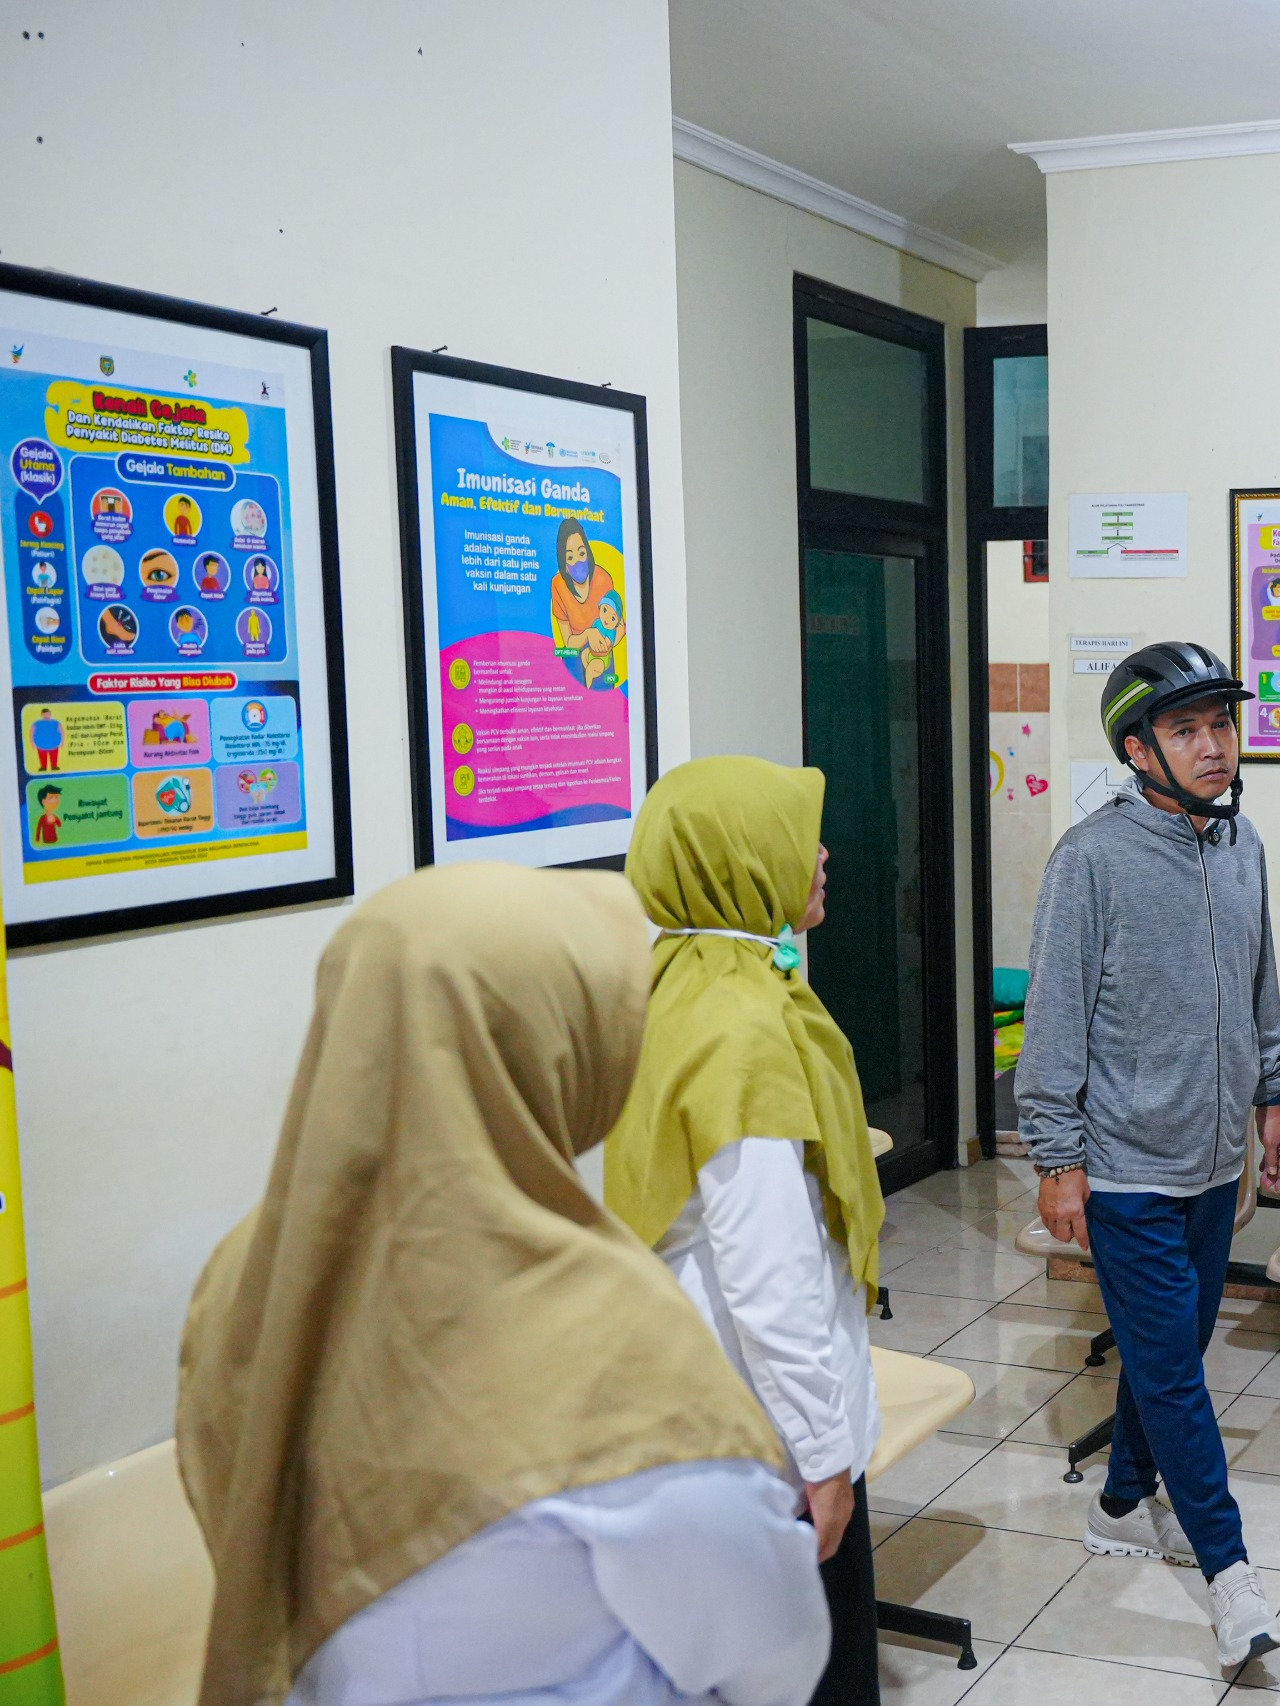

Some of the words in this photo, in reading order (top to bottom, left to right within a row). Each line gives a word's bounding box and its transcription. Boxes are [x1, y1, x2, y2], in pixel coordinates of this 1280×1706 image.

[93, 391, 148, 418] Kenali
[150, 399, 206, 425] Gejala
[68, 410, 91, 425] Dan
[93, 413, 155, 434] Kendalikan
[158, 422, 195, 438] Faktor
[197, 427, 230, 441] Resiko
[66, 424, 119, 443] Penyakit
[121, 431, 168, 448] Diabetes
[170, 437, 209, 453] Melitus
[211, 442, 233, 456] (DM)
[20, 447, 53, 461] Gejala
[20, 459, 55, 472] Utama
[126, 459, 165, 477] Gejala
[167, 463, 226, 481] Tambahan
[21, 470, 55, 485] (klasik)
[457, 468, 537, 497] Imunisasi
[541, 478, 591, 504] Ganda
[441, 492, 477, 510] Aman,
[479, 496, 520, 513] Efektif
[522, 500, 542, 516] dan
[544, 503, 605, 523] Bermanfaat
[464, 529, 504, 542] Imunisasi
[505, 532, 530, 546] ganda
[464, 543, 493, 554] adalah
[494, 546, 537, 558] pemberian
[461, 554, 483, 566] lebih
[484, 557, 501, 567] dari
[502, 558, 520, 569] satu
[520, 558, 540, 571] jenis
[465, 568, 493, 579] vaksin
[494, 570, 519, 581] dalam
[520, 572, 538, 582] satu
[473, 580, 489, 591] kali
[490, 582, 531, 596] kunjungan
[97, 678, 129, 689] Faktor
[130, 677, 157, 688] Risiko
[158, 677, 182, 690] Yang
[182, 676, 201, 687] Bisa
[202, 675, 233, 686] Diubah
[1261, 674, 1267, 684] 1
[1260, 707, 1268, 718] 4
